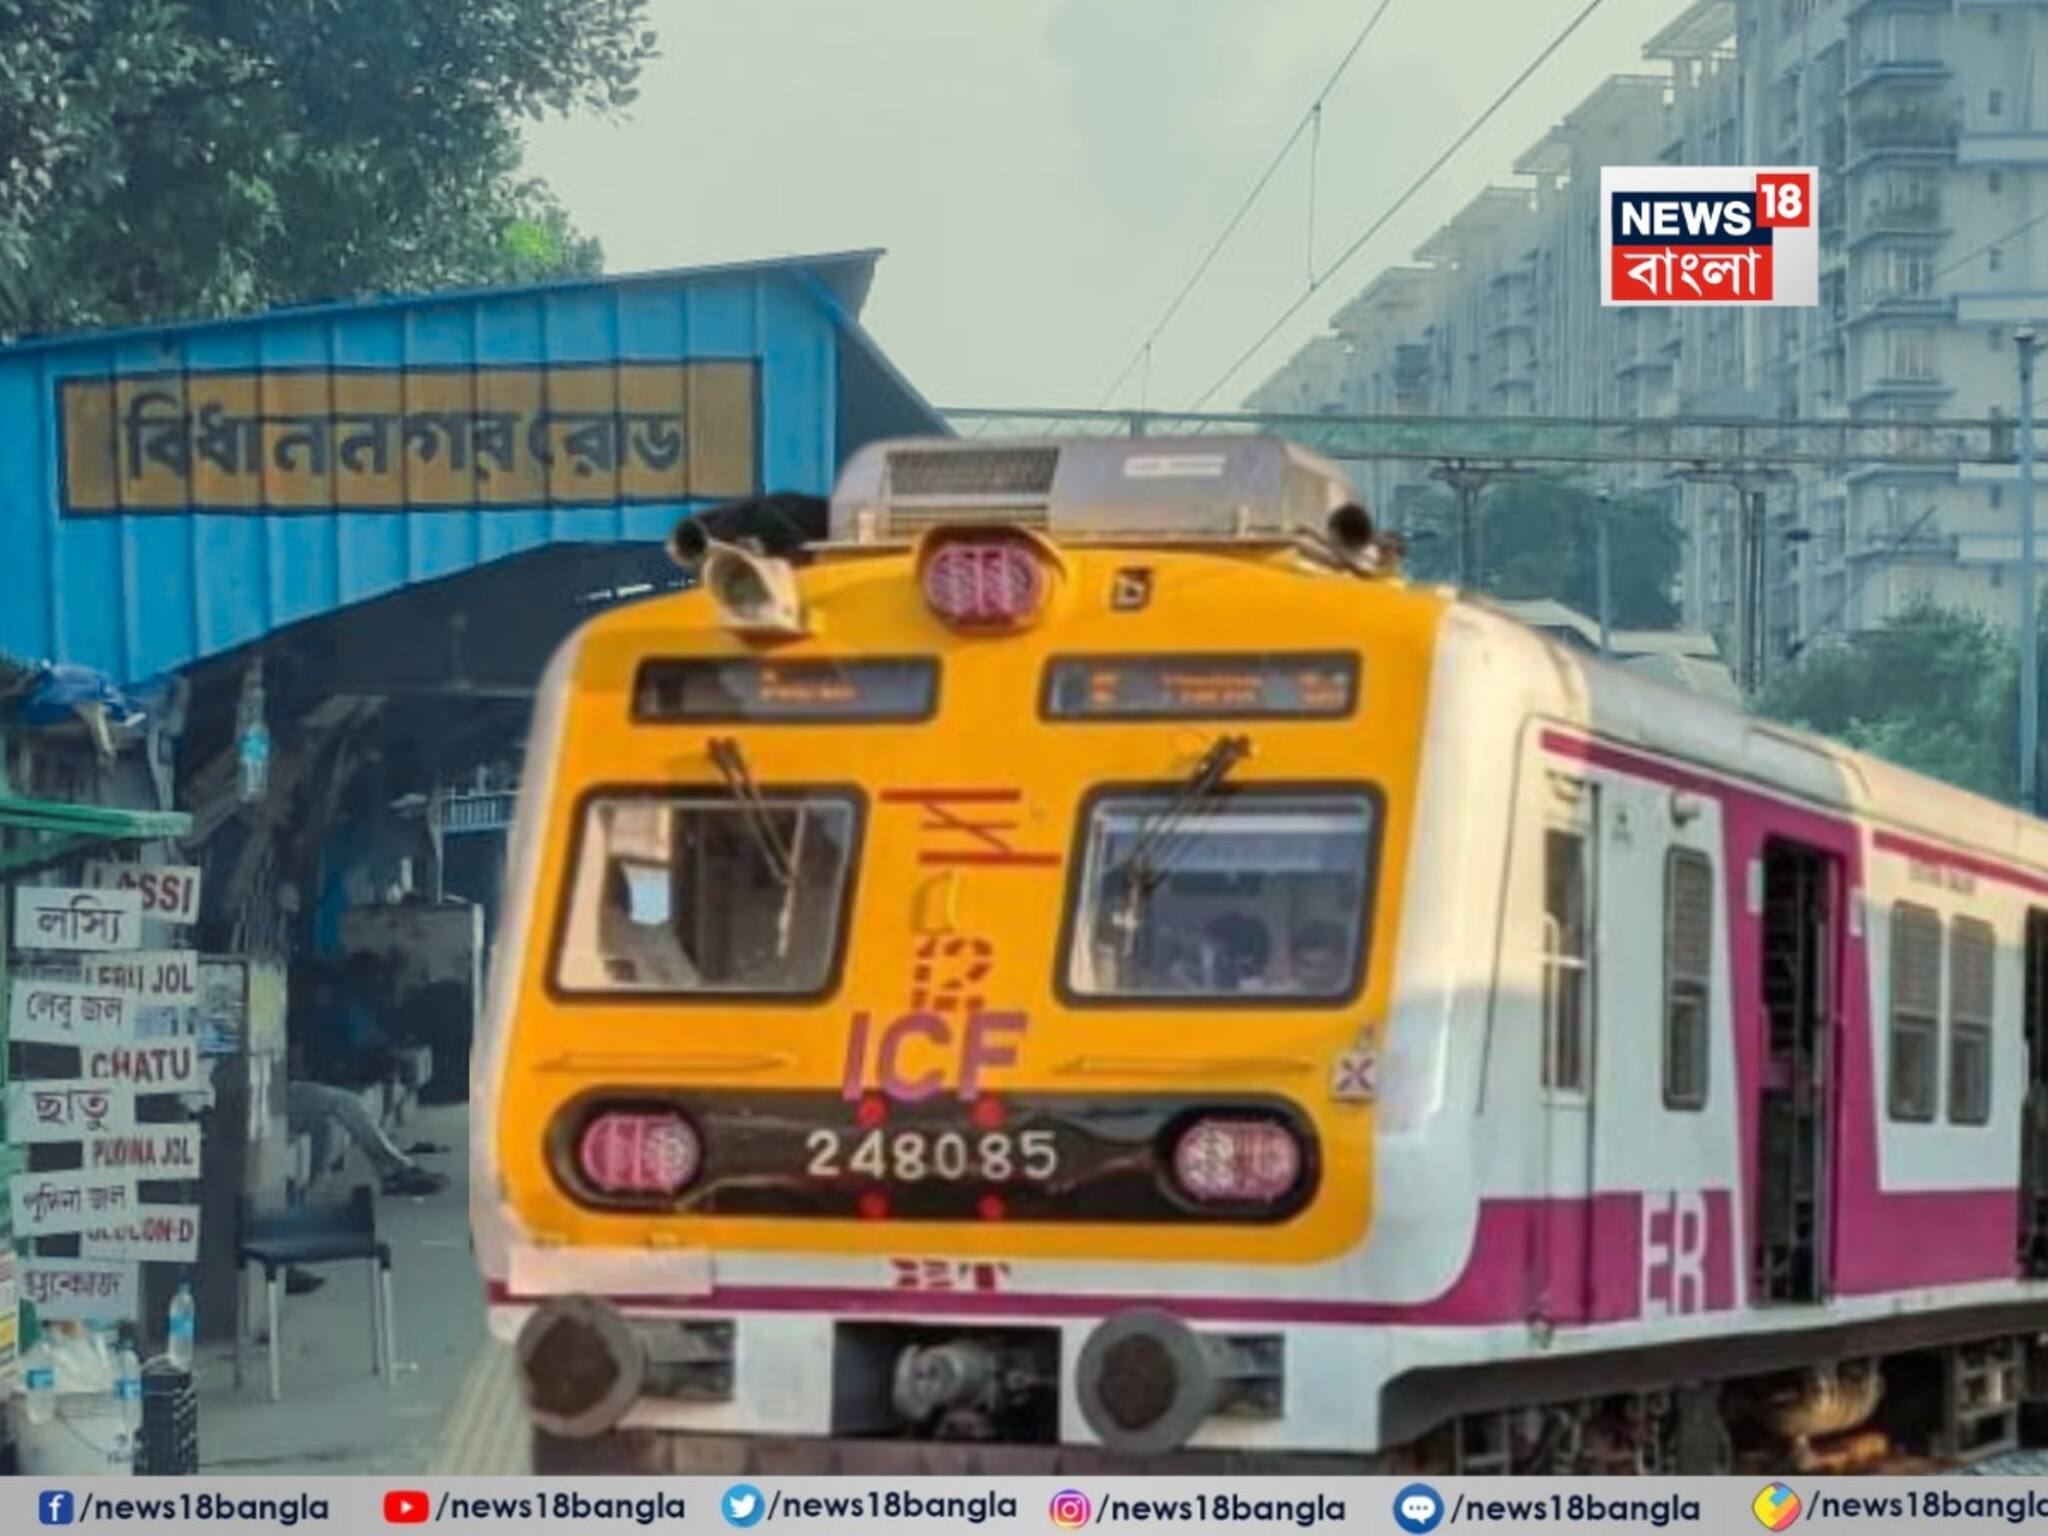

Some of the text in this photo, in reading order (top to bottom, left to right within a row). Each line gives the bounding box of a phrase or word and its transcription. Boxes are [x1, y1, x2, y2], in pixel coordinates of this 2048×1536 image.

[527, 408, 686, 478] রোড
[152, 963, 194, 994] JOL
[91, 1046, 192, 1083] CHATU
[842, 1009, 1029, 1103] ICF
[806, 1128, 1058, 1181] 248085
[1641, 1188, 1708, 1318] ER
